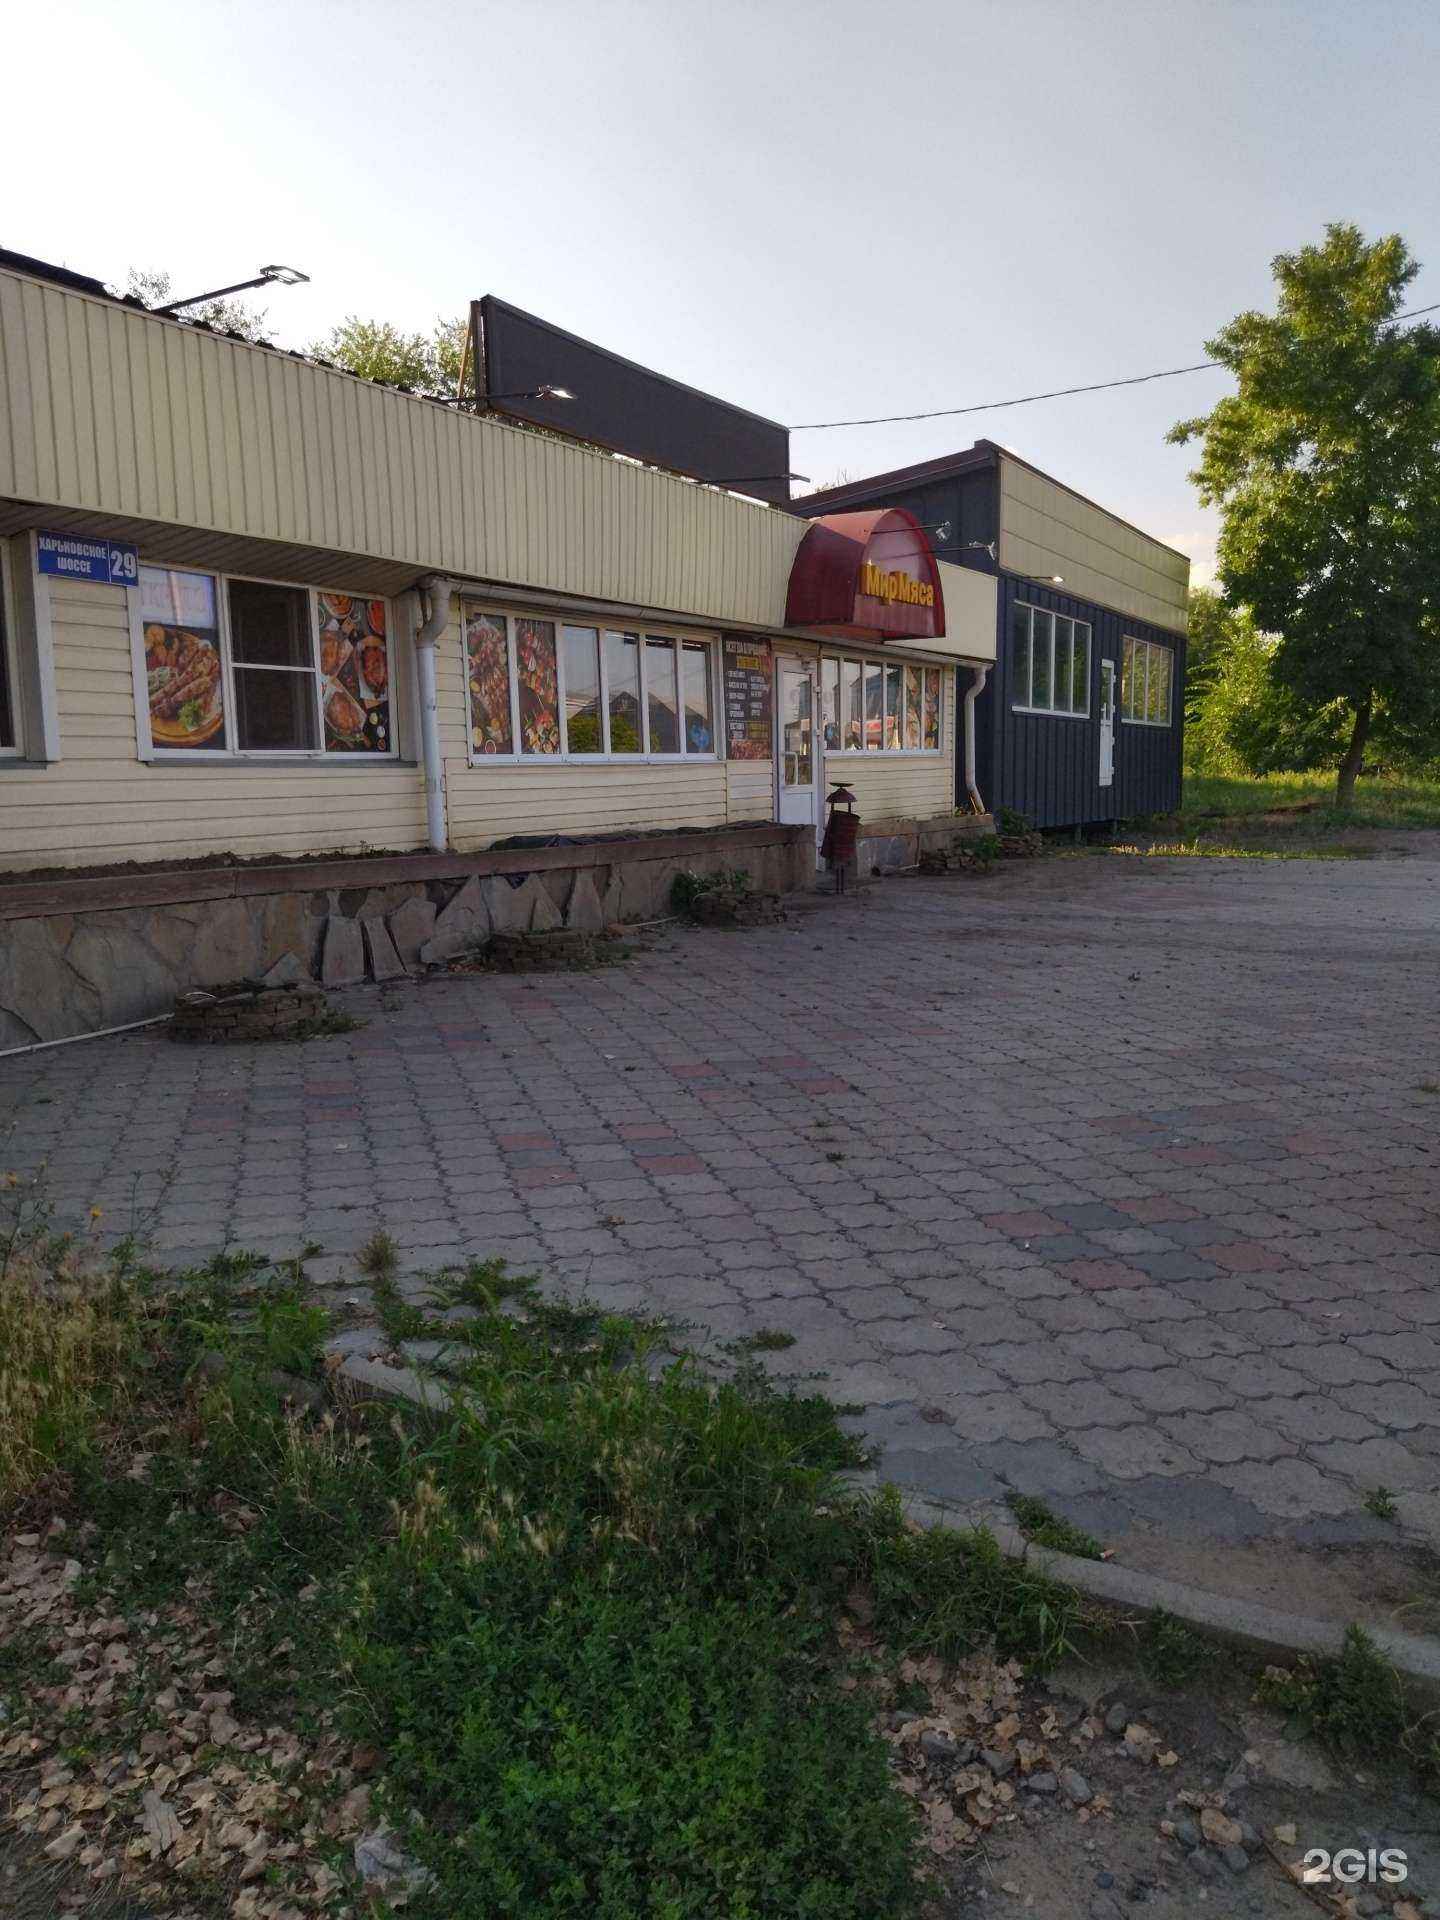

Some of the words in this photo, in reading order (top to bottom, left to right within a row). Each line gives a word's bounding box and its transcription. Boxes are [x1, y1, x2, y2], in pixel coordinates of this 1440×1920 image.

[39, 536, 107, 559] ХАРЬКОВСКОЕ
[57, 556, 92, 573] ШОССЕ
[111, 550, 136, 578] 29
[863, 564, 899, 605] Мир
[899, 571, 934, 607] Мяса
